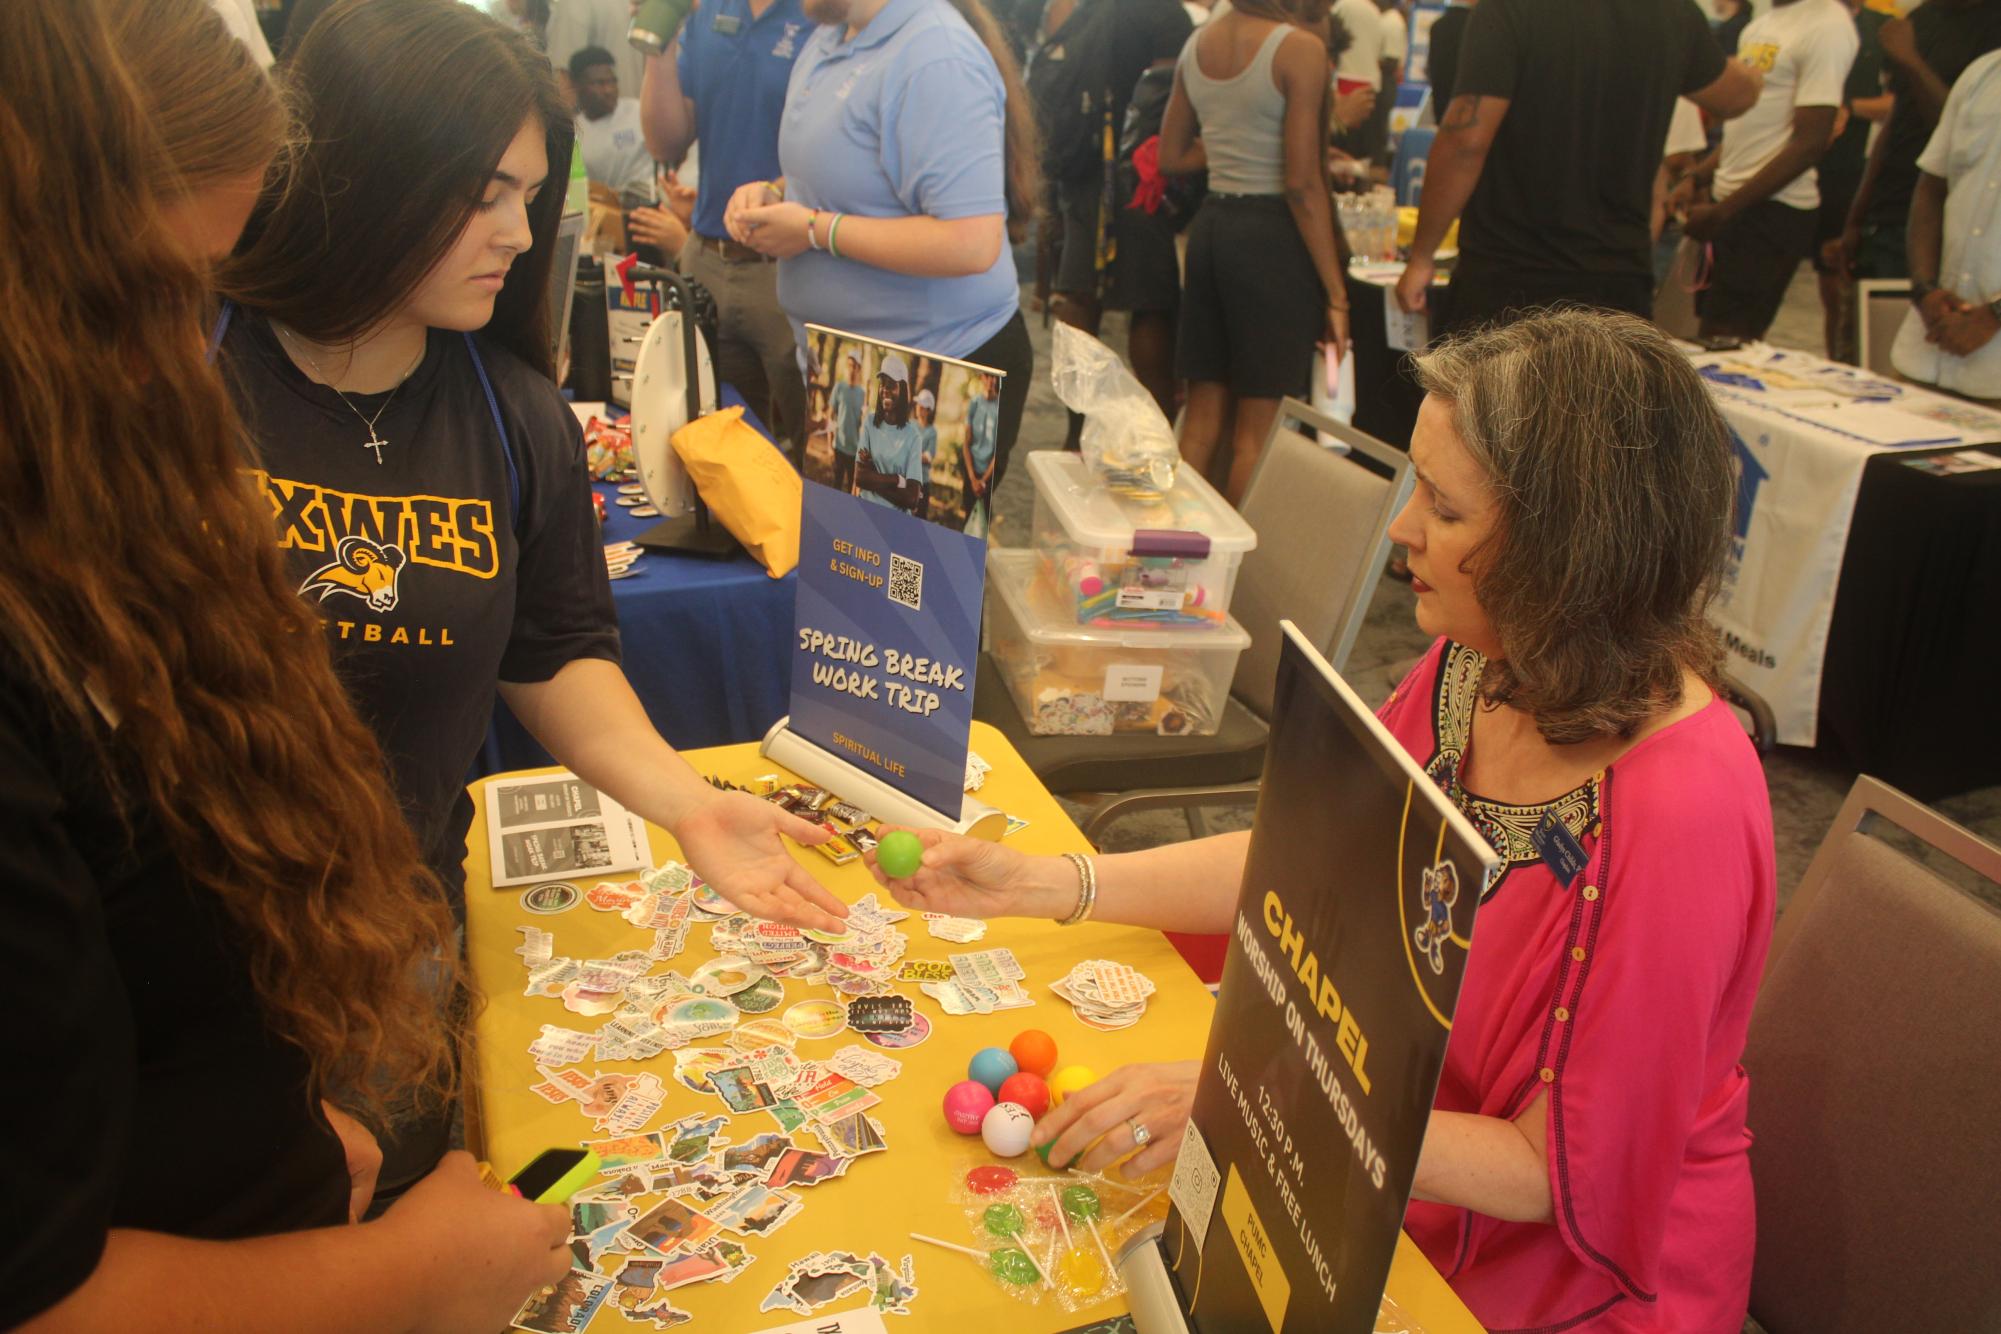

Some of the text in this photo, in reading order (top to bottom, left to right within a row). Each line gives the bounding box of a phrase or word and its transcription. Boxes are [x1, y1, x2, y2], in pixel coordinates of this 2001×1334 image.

[237, 468, 500, 580] XWES
[830, 558, 884, 588] & SIGN-UP
[833, 539, 881, 568] GET INFO
[799, 627, 965, 691] SPRING BREAK
[1725, 630, 1777, 670] Meals
[812, 660, 940, 717] WORK TRIP
[832, 731, 905, 778] SPIRITUAL LIFE
[904, 970, 950, 981] BLESS
[914, 962, 953, 973] GOD
[1262, 890, 1372, 1095] CHAPEL
[1237, 911, 1387, 1189] WORSHIP ON THURSDAYS
[1257, 1084, 1305, 1187] 12:30 P.M.
[1218, 1053, 1338, 1302] LIVE MUSIC & FREE LUNCH
[695, 1236, 718, 1253] Utah
[1238, 1233, 1264, 1288] CHAPEL
[1246, 1212, 1268, 1259] PUMC
